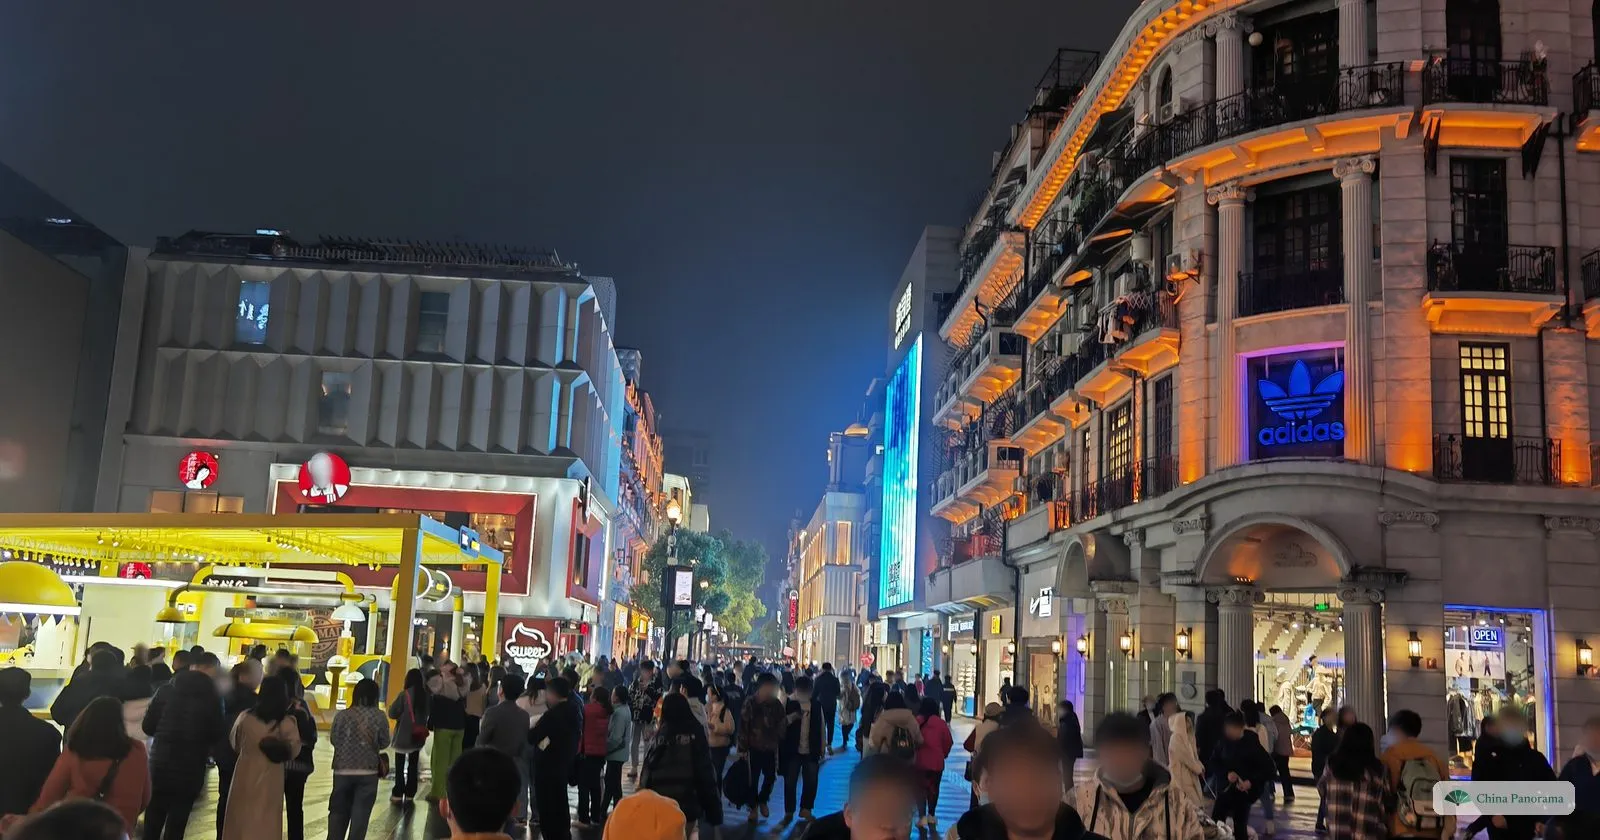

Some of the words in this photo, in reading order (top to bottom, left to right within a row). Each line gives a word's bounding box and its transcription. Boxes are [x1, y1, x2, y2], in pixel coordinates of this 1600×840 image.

[1258, 420, 1344, 446] adidas
[1474, 630, 1497, 641] OPEN
[509, 645, 545, 658] sweet
